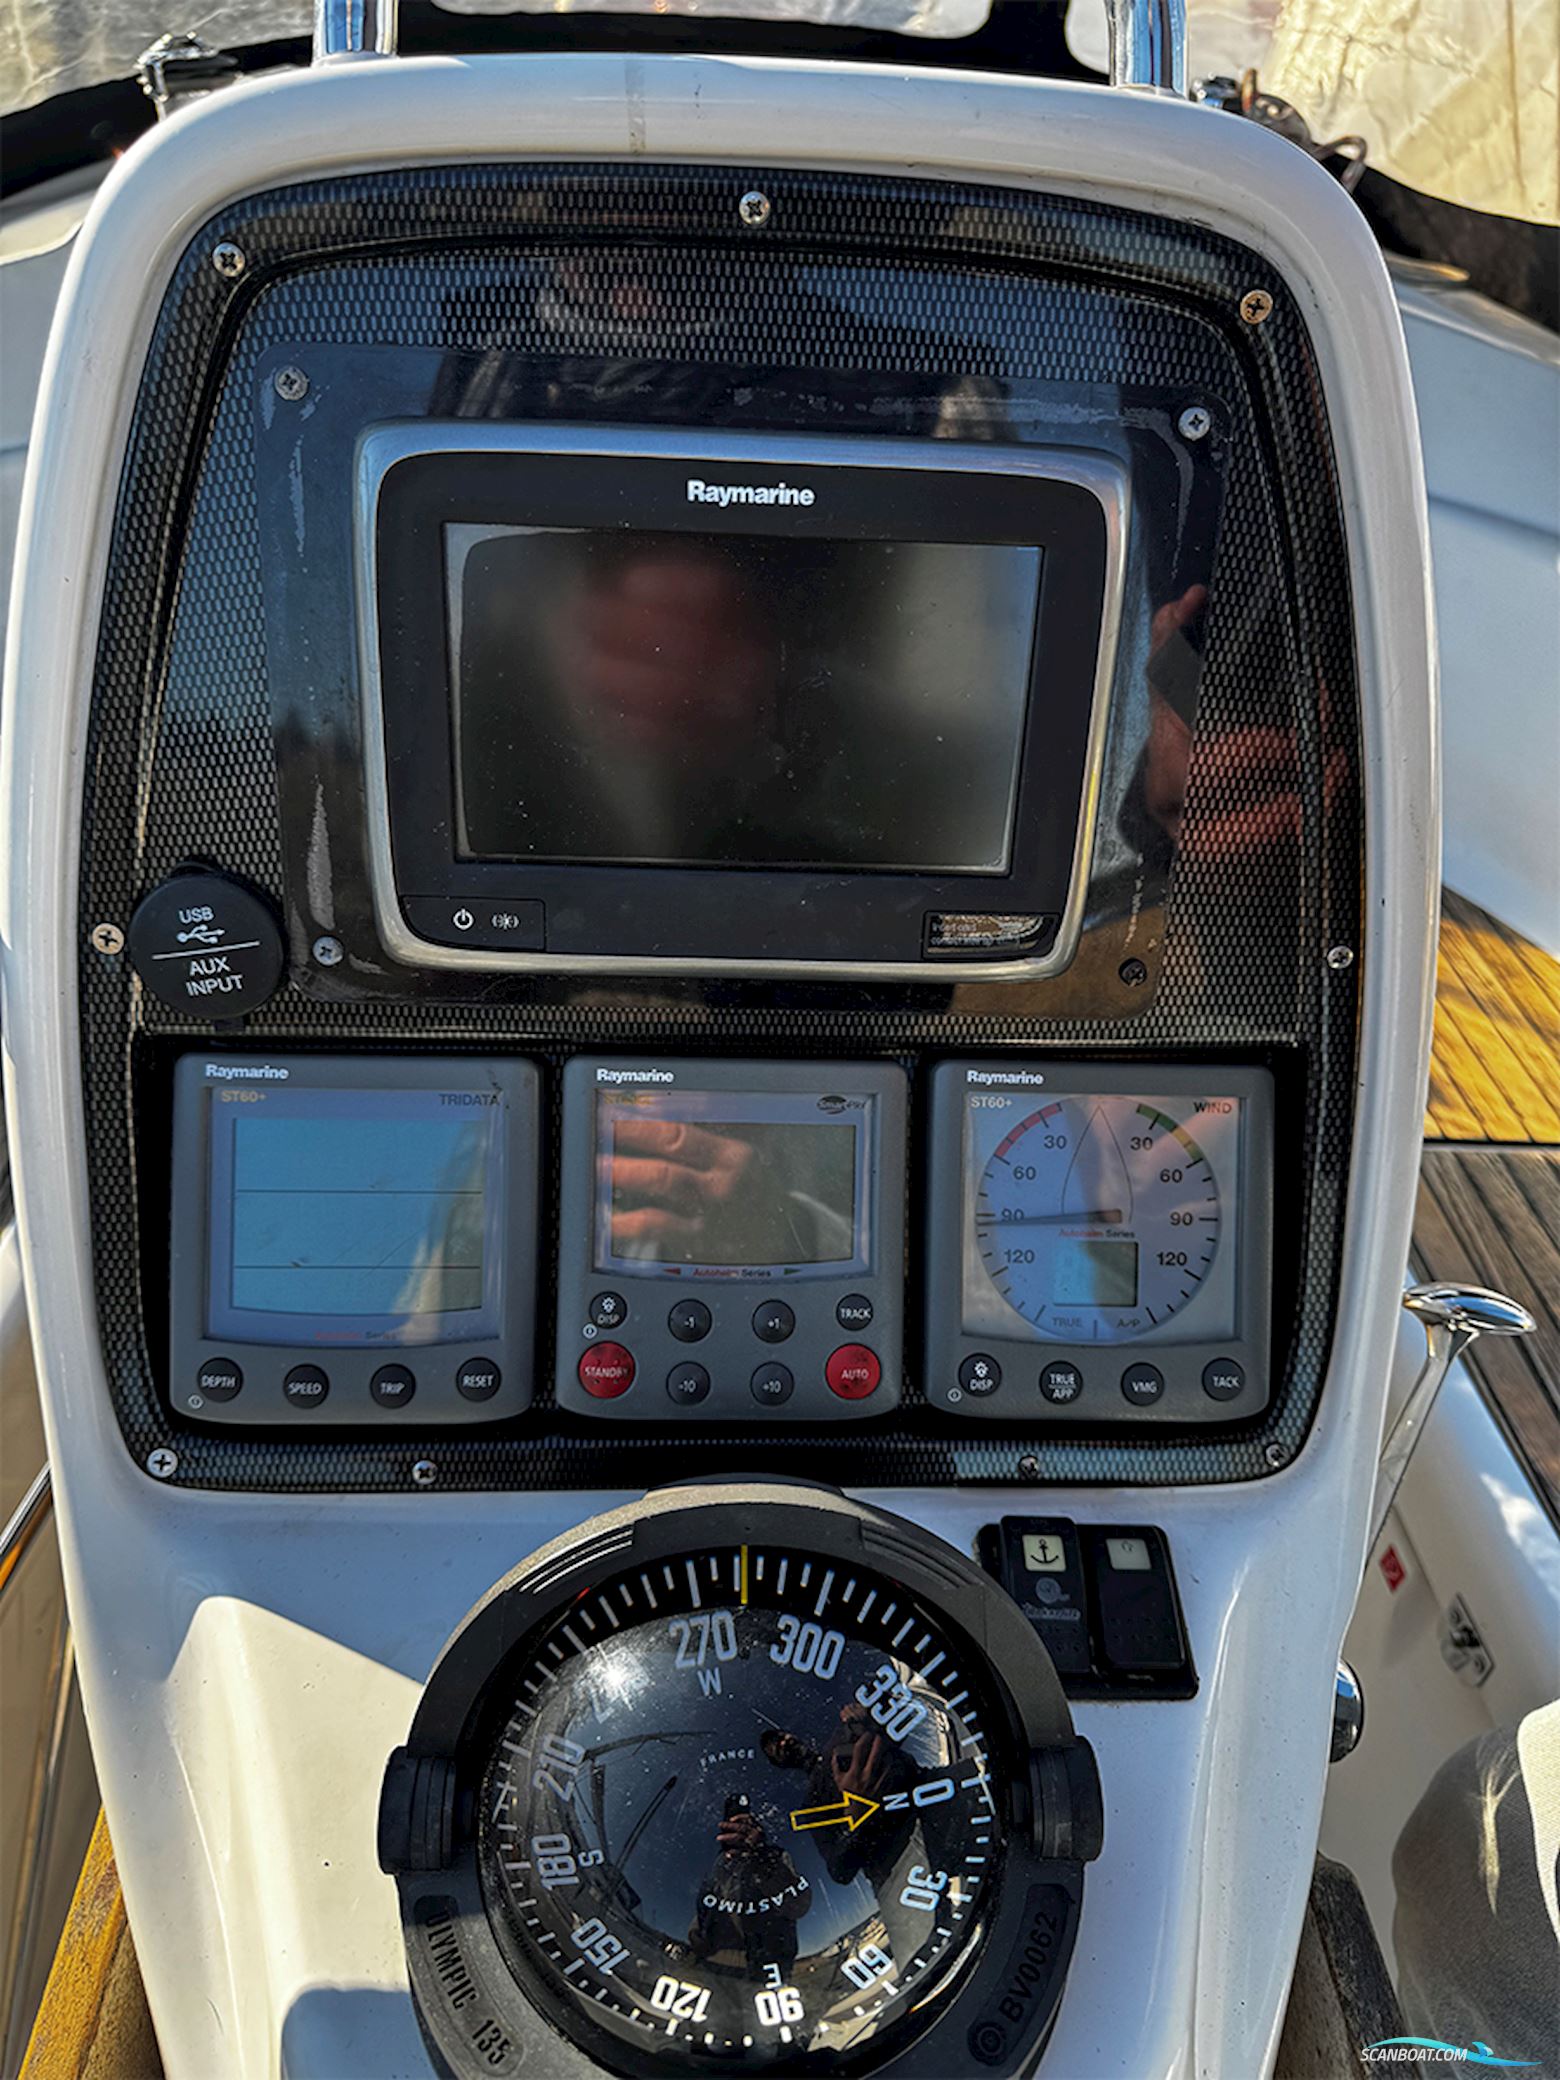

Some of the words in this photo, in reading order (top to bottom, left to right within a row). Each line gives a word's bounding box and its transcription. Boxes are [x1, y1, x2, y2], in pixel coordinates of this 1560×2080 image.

[687, 480, 815, 507] Raymarine
[179, 906, 214, 924] USB
[190, 957, 231, 976] AUX
[186, 974, 243, 996] INPUT
[205, 1064, 289, 1081] Raymarine
[596, 1068, 674, 1085] Raymarine
[967, 1070, 1044, 1086] Raymarine
[221, 1090, 266, 1103] ST60+
[439, 1093, 500, 1107] TRIDATA
[971, 1096, 1013, 1109] ST60+
[1194, 1102, 1232, 1114] WIND
[1044, 1135, 1067, 1149] 30
[1130, 1137, 1153, 1151] 30
[1013, 1167, 1036, 1181] 60
[1160, 1169, 1183, 1183] 60
[1001, 1209, 1024, 1223] 90
[1170, 1212, 1193, 1226] 90
[1105, 1229, 1135, 1239] Series
[1004, 1249, 1035, 1264] 120
[1157, 1252, 1188, 1266] 120
[741, 1269, 771, 1279] Series
[597, 1314, 619, 1326] DISP
[840, 1306, 871, 1320] TRACK
[768, 1317, 780, 1329] +1
[1052, 1317, 1082, 1329] TRUE
[585, 1366, 628, 1378] STANDBY
[841, 1369, 869, 1380] AUTO
[201, 1374, 236, 1388] DEPTH
[463, 1374, 493, 1387] RESET
[970, 1379, 993, 1390] DISP
[1050, 1373, 1075, 1386] TRUE
[1213, 1376, 1239, 1387] TACK
[288, 1382, 322, 1396] SPEED
[380, 1382, 405, 1394] TRIP
[762, 1381, 781, 1393] +10
[1052, 1388, 1074, 1400] APP
[1132, 1381, 1157, 1393] VMG
[669, 1610, 737, 1669] 270
[769, 1614, 845, 1680] 300
[698, 1667, 722, 1696] W
[855, 1664, 928, 1742] 330
[700, 1749, 754, 1767] FRANCE
[533, 1733, 586, 1802] 210
[912, 1778, 955, 1807] 0
[882, 1792, 910, 1811] N
[532, 1833, 580, 1891] 180
[579, 1849, 604, 1867] S
[703, 1876, 809, 1914] PLASTIMO
[900, 1866, 948, 1912] 30
[571, 1917, 630, 1975] 150
[841, 1944, 892, 1990] 60
[1000, 1912, 1058, 2023] BV0062
[763, 1963, 782, 1989] E
[426, 1913, 479, 2010] OLYMPIC
[472, 2019, 511, 2066] 135
[651, 1975, 712, 2022] 120
[754, 1987, 804, 2026] 90
